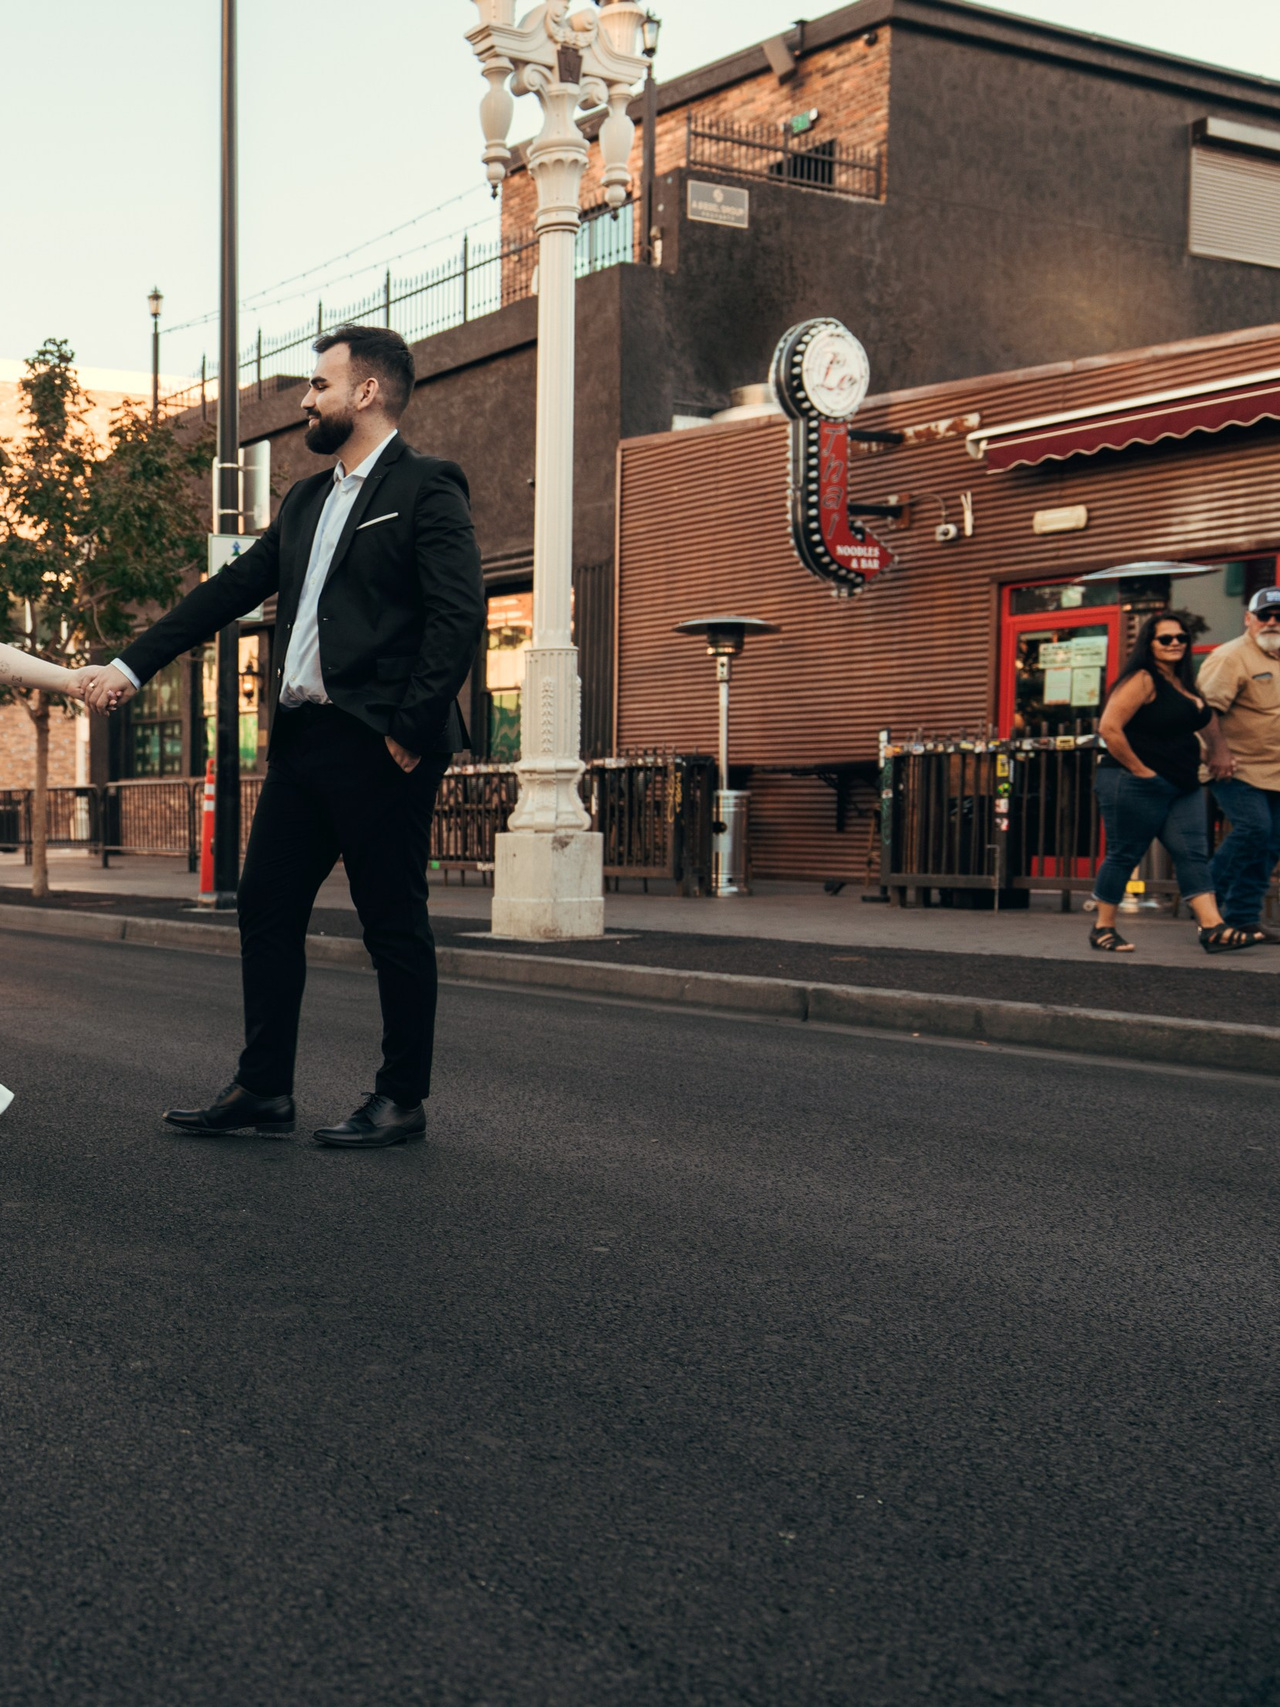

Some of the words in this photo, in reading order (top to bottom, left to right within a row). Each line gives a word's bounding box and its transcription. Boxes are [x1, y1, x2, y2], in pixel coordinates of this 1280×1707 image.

[822, 426, 846, 540] Thai
[836, 545, 880, 557] NOODLES
[851, 558, 859, 568] &
[861, 558, 880, 569] BAR
